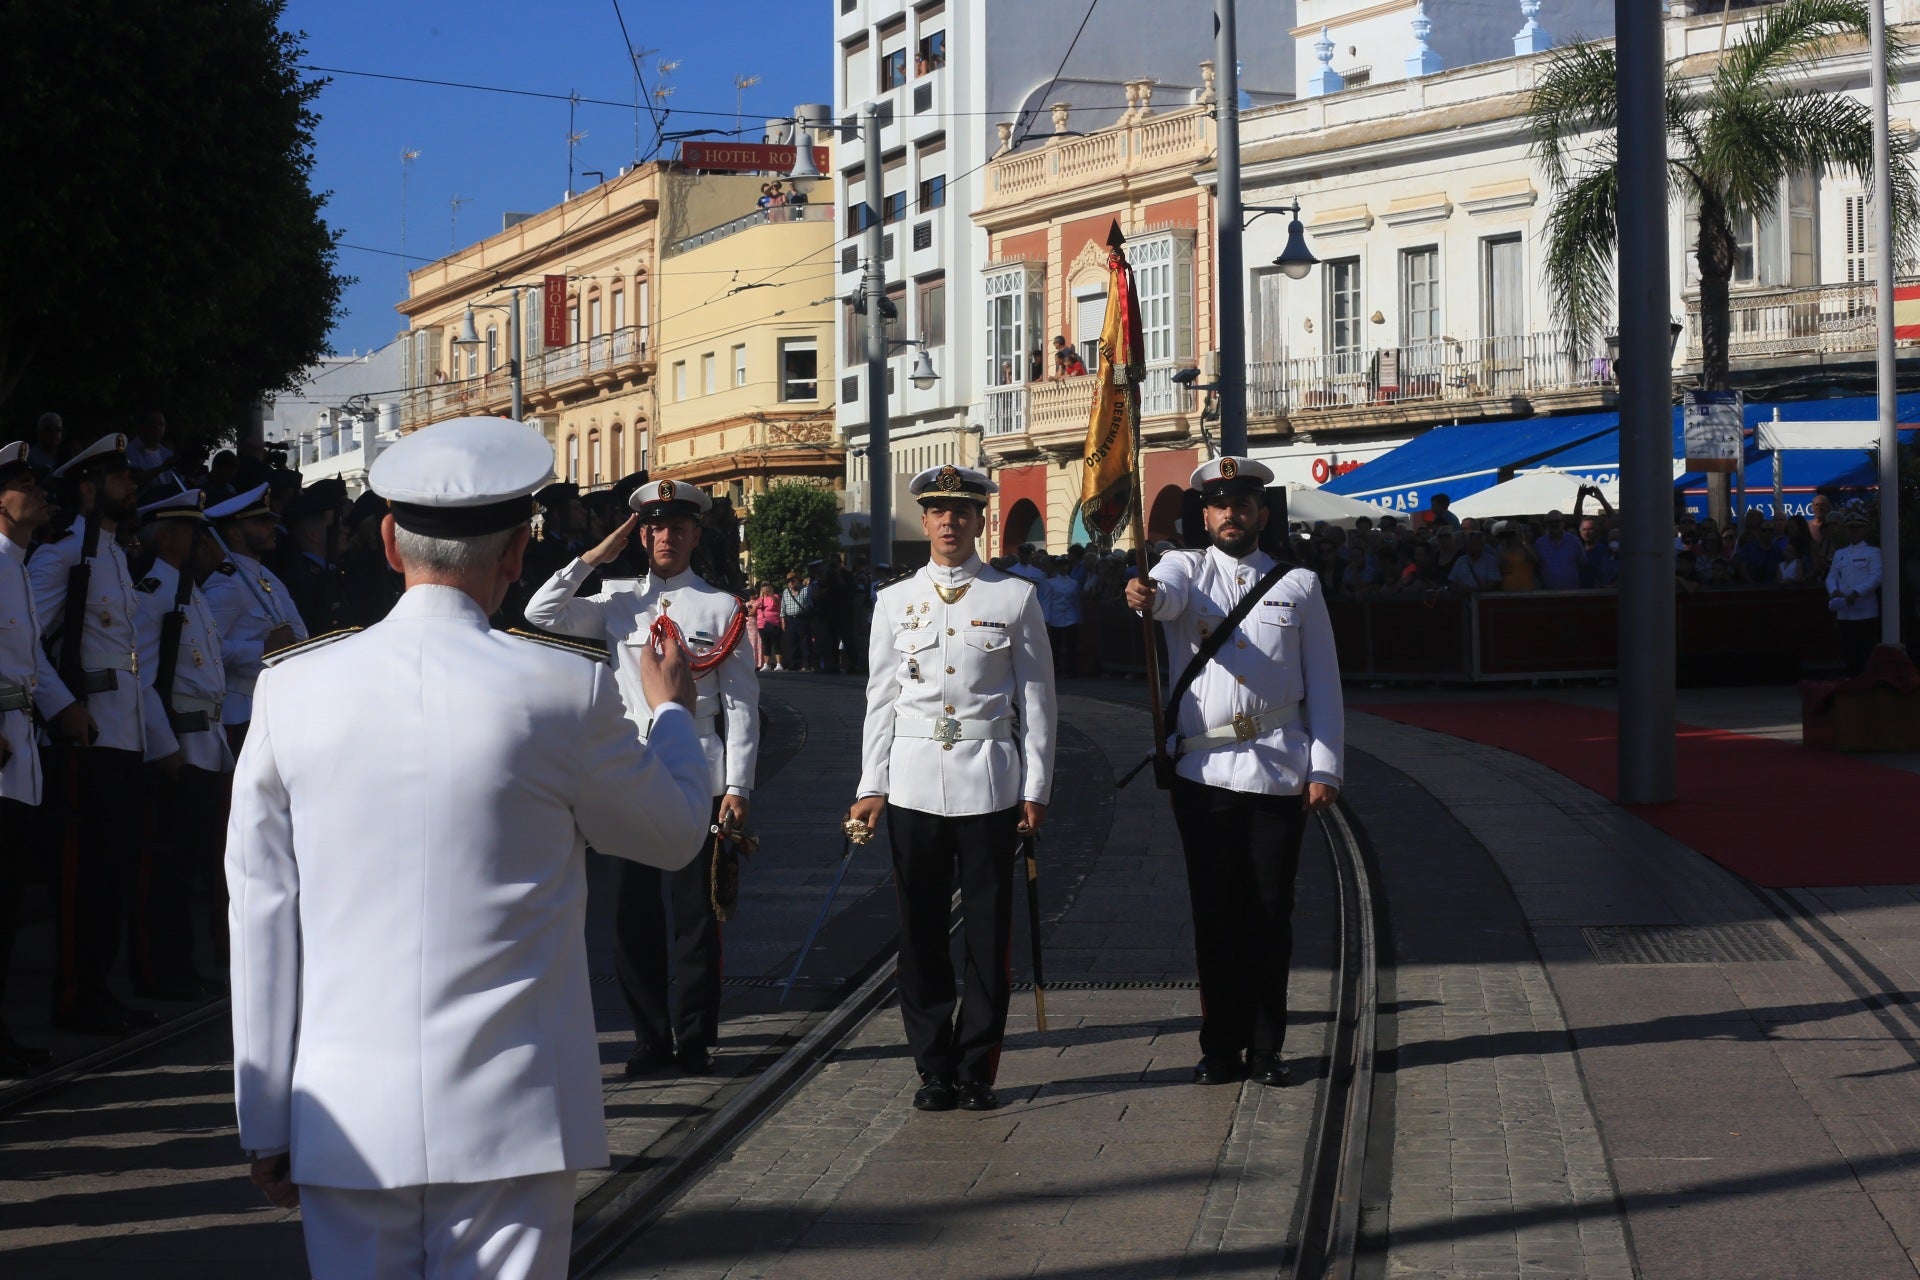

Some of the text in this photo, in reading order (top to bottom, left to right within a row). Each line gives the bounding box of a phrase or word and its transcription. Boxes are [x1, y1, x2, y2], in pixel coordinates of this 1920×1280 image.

[705, 149, 797, 165] HOTEL RO
[549, 280, 562, 341] HOTEL
[1085, 400, 1125, 468] DESEMBARCO
[1363, 491, 1419, 512] APAS
